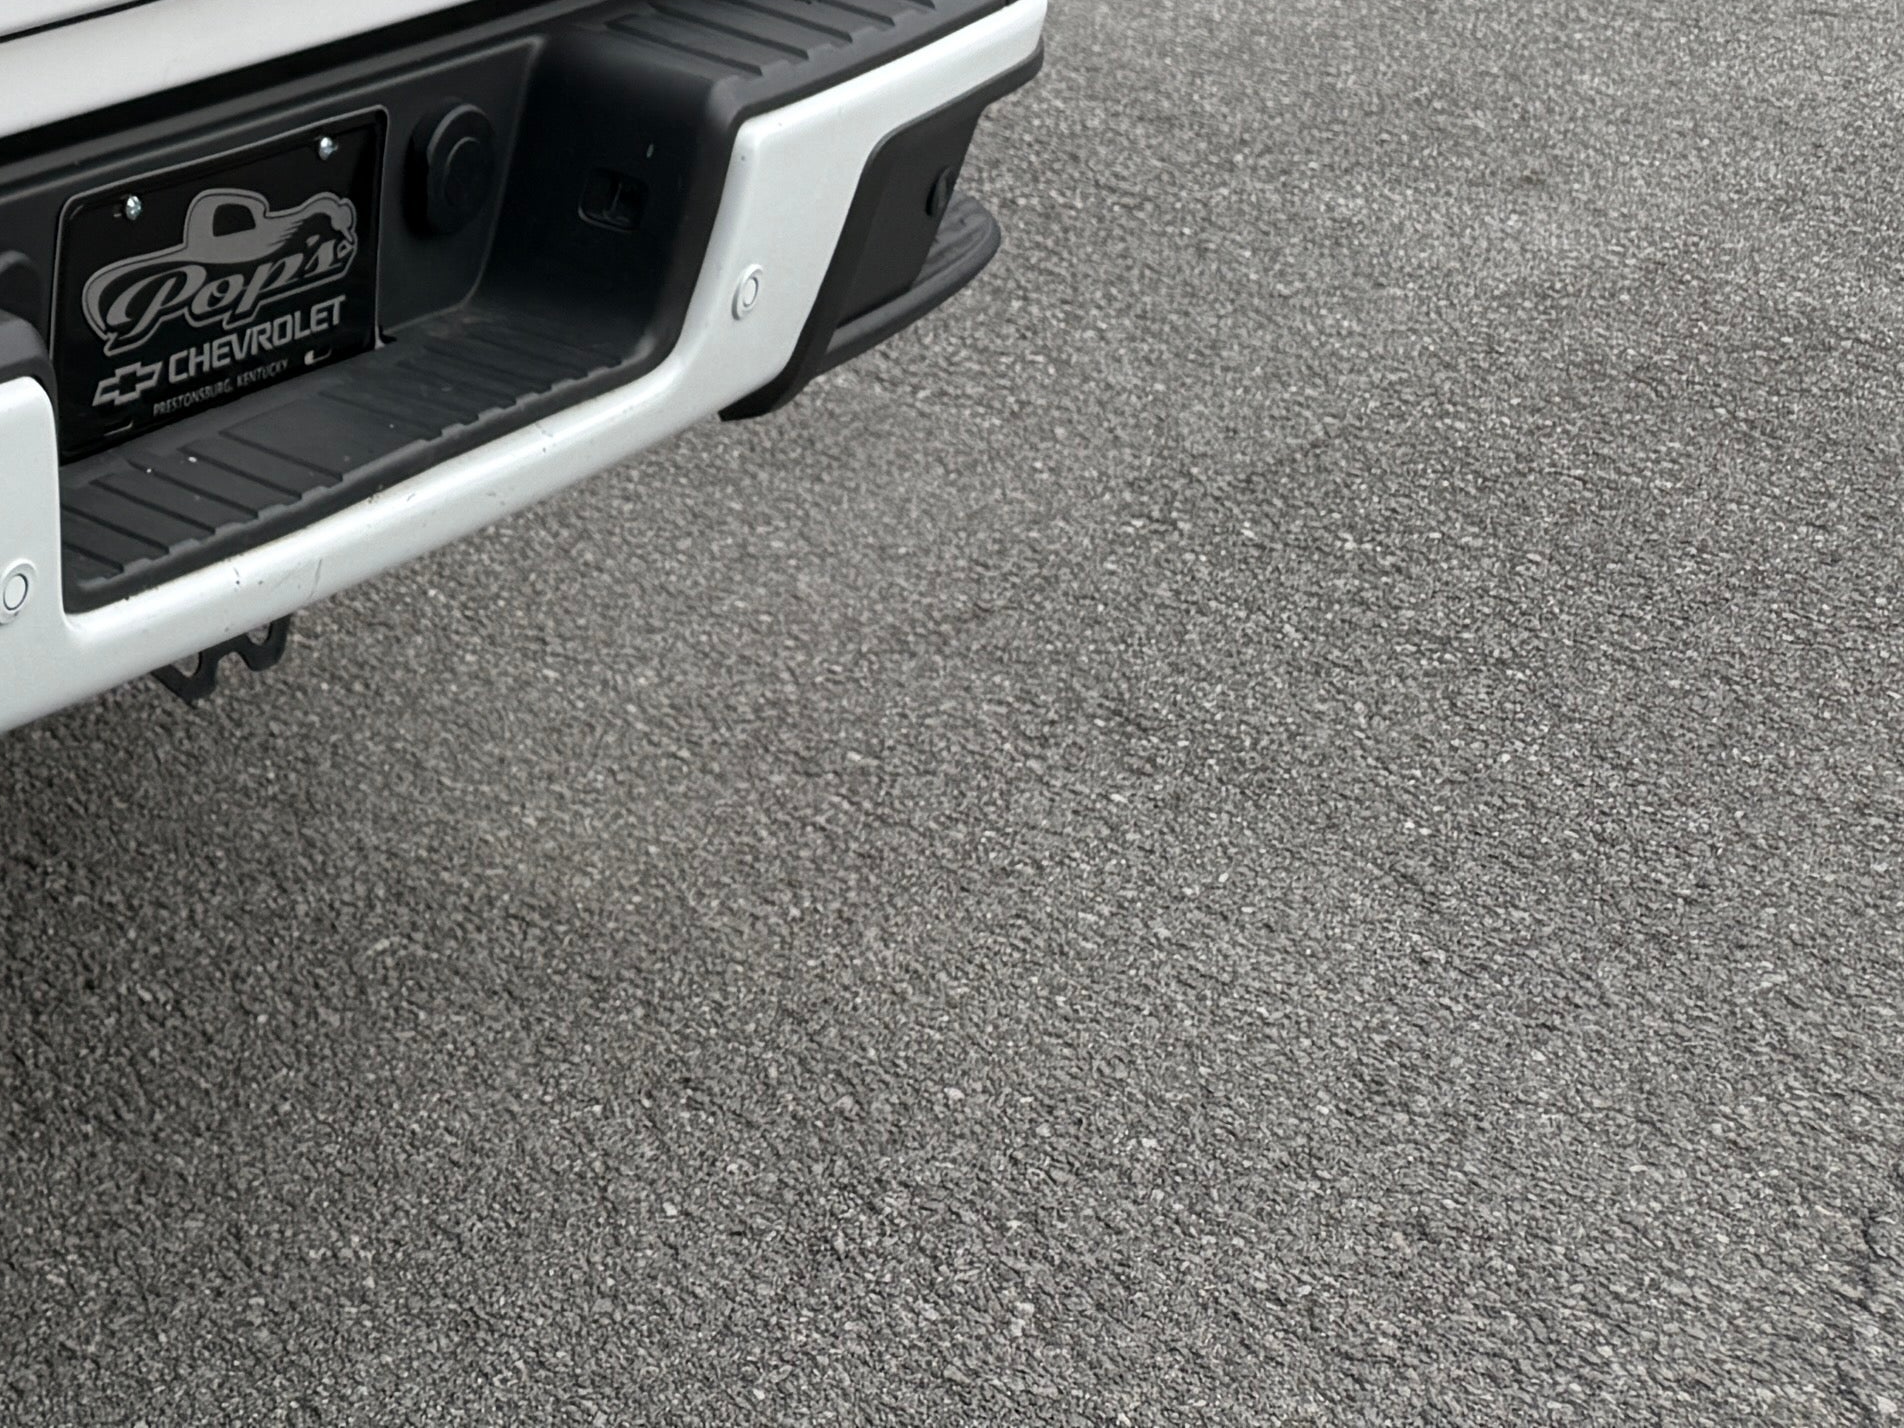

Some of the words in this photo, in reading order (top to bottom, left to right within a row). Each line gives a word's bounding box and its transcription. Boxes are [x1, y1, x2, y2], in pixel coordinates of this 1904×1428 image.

[106, 235, 350, 339] Pop's
[168, 295, 346, 385] CHEVROLET
[237, 358, 289, 388] KENTUCKY
